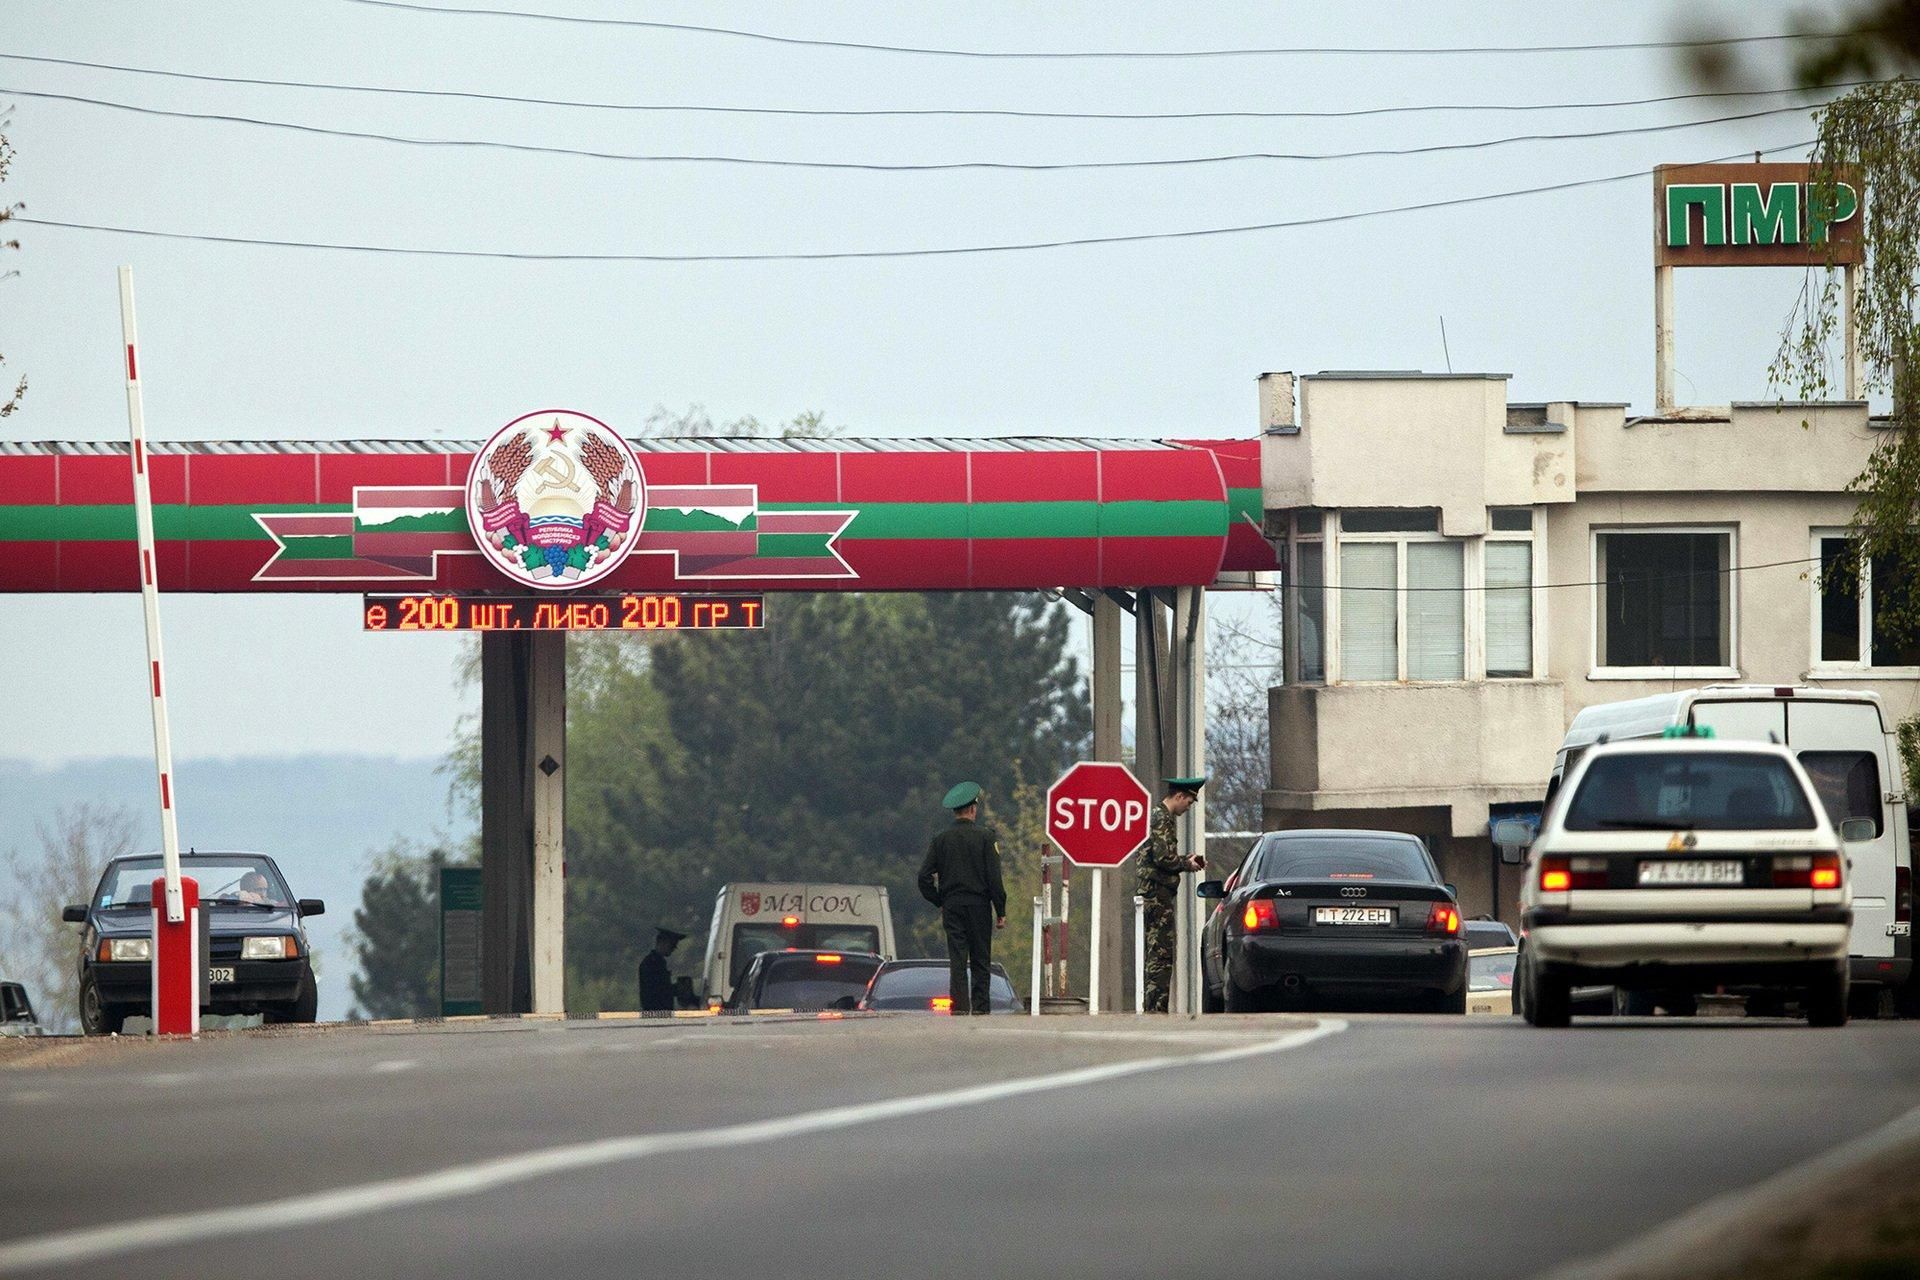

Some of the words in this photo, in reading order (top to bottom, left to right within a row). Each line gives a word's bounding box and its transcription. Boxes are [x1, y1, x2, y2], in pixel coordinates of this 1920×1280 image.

[1666, 182, 1858, 246] ПМР
[399, 597, 459, 629] 200
[533, 604, 609, 629] ЛИБО
[621, 596, 681, 628] 200
[1054, 797, 1143, 831] STOP
[764, 893, 862, 916] MACON
[1329, 909, 1338, 920] T
[1342, 909, 1365, 920] 272
[1368, 910, 1386, 920] EH
